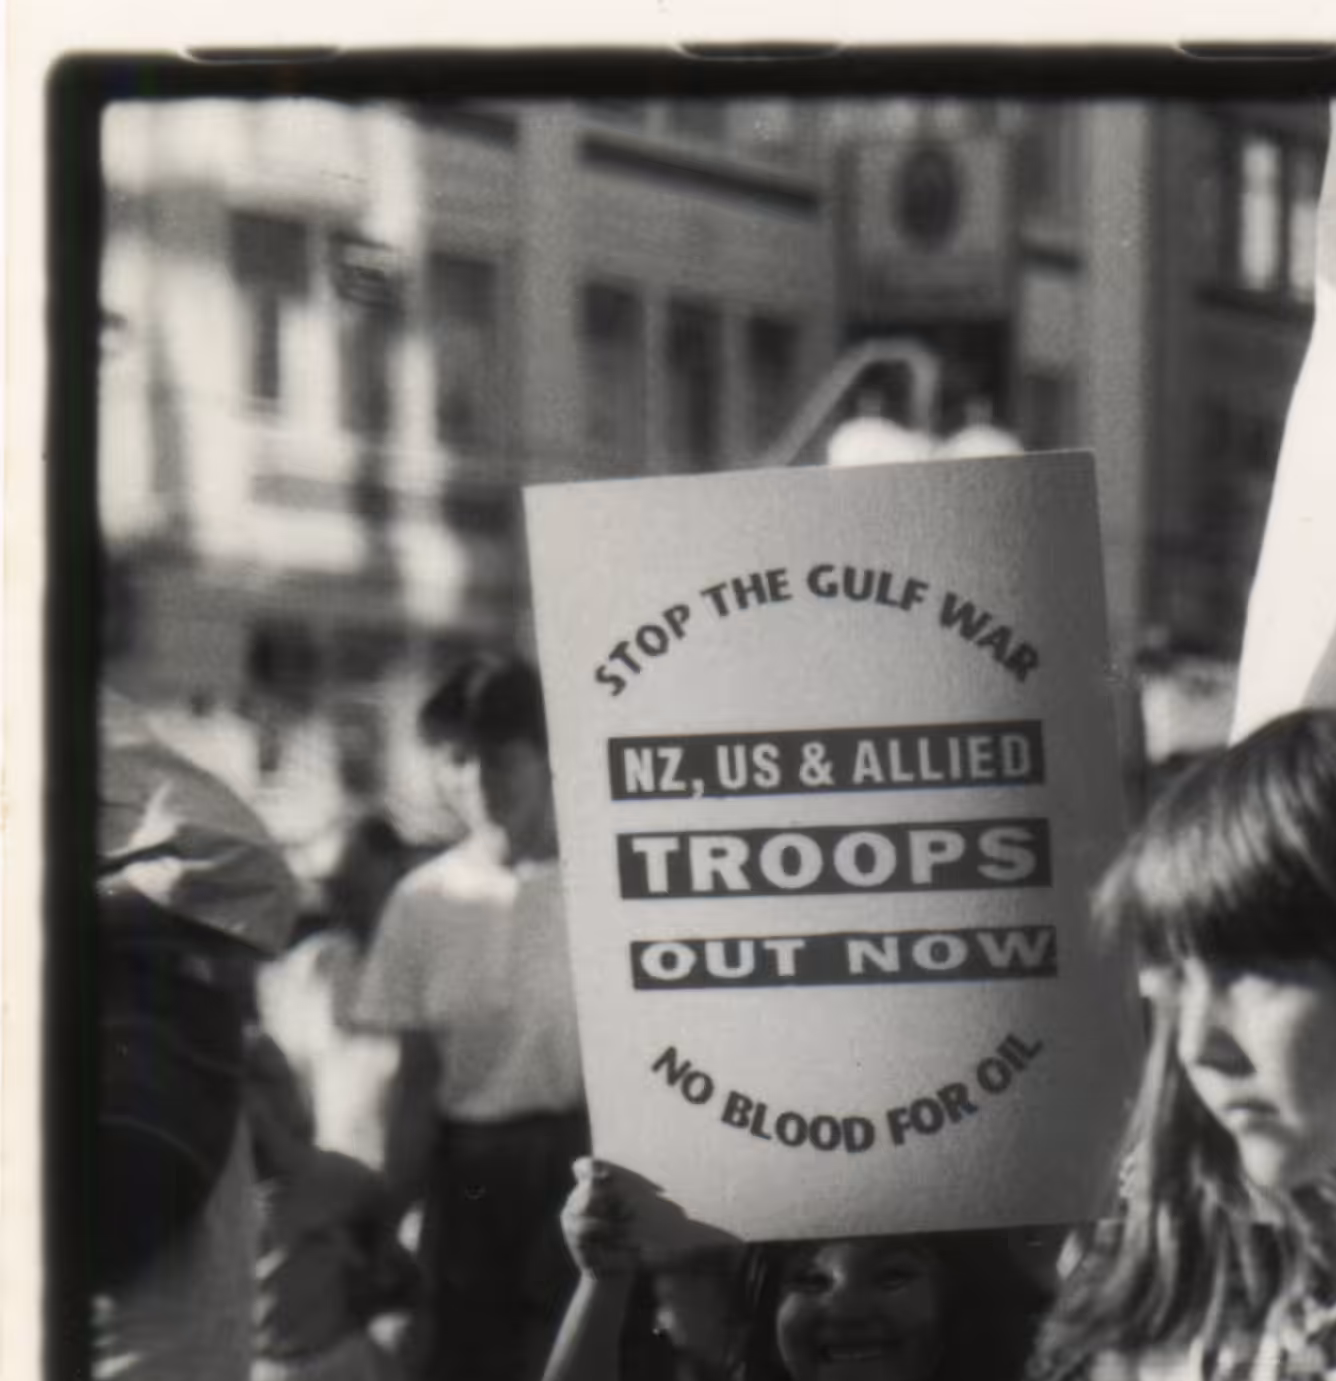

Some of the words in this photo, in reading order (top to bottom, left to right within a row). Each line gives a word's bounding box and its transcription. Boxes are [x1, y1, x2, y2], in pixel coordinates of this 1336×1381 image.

[593, 603, 692, 698] STOP
[700, 566, 792, 620] THE
[806, 563, 929, 613] GULF
[937, 593, 1041, 684] WAR
[622, 744, 706, 800] NZ,
[716, 742, 781, 790] US
[799, 742, 834, 787] &
[851, 733, 1033, 787] ALLIED
[631, 826, 1039, 894] TROOPS
[639, 937, 806, 981] OUT
[846, 928, 1056, 976] NOW
[649, 1045, 714, 1105] NO
[719, 1091, 876, 1154] BLOOD
[887, 1083, 979, 1148] FOR
[976, 1032, 1044, 1099] OIL
